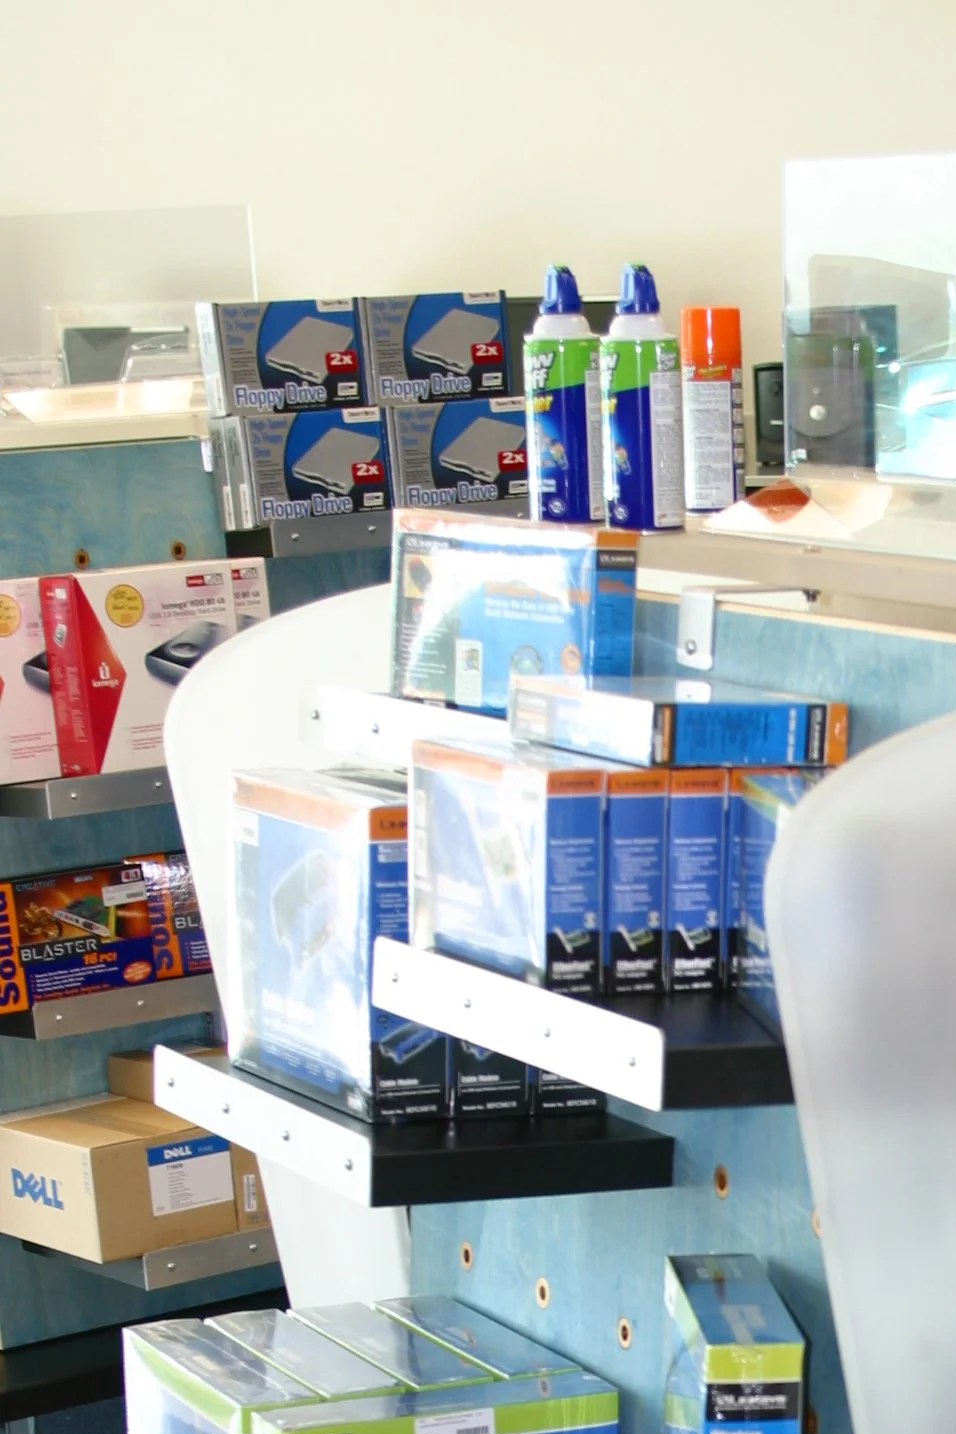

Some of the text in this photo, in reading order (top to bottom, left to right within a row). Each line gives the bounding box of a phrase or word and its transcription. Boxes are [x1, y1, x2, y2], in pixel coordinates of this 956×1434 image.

[330, 353, 353, 366] 2x
[475, 345, 498, 357] 2x
[235, 381, 327, 411] Floppy Drive
[380, 372, 472, 401] Floppy Drive
[356, 464, 379, 476] 2x
[502, 452, 525, 464] 2x
[407, 482, 498, 508] Floppy Drive
[261, 494, 353, 522] Floppy Drive
[20, 938, 98, 962] BLASTER
[163, 1145, 193, 1160] DELL
[11, 1168, 64, 1210] DELL
